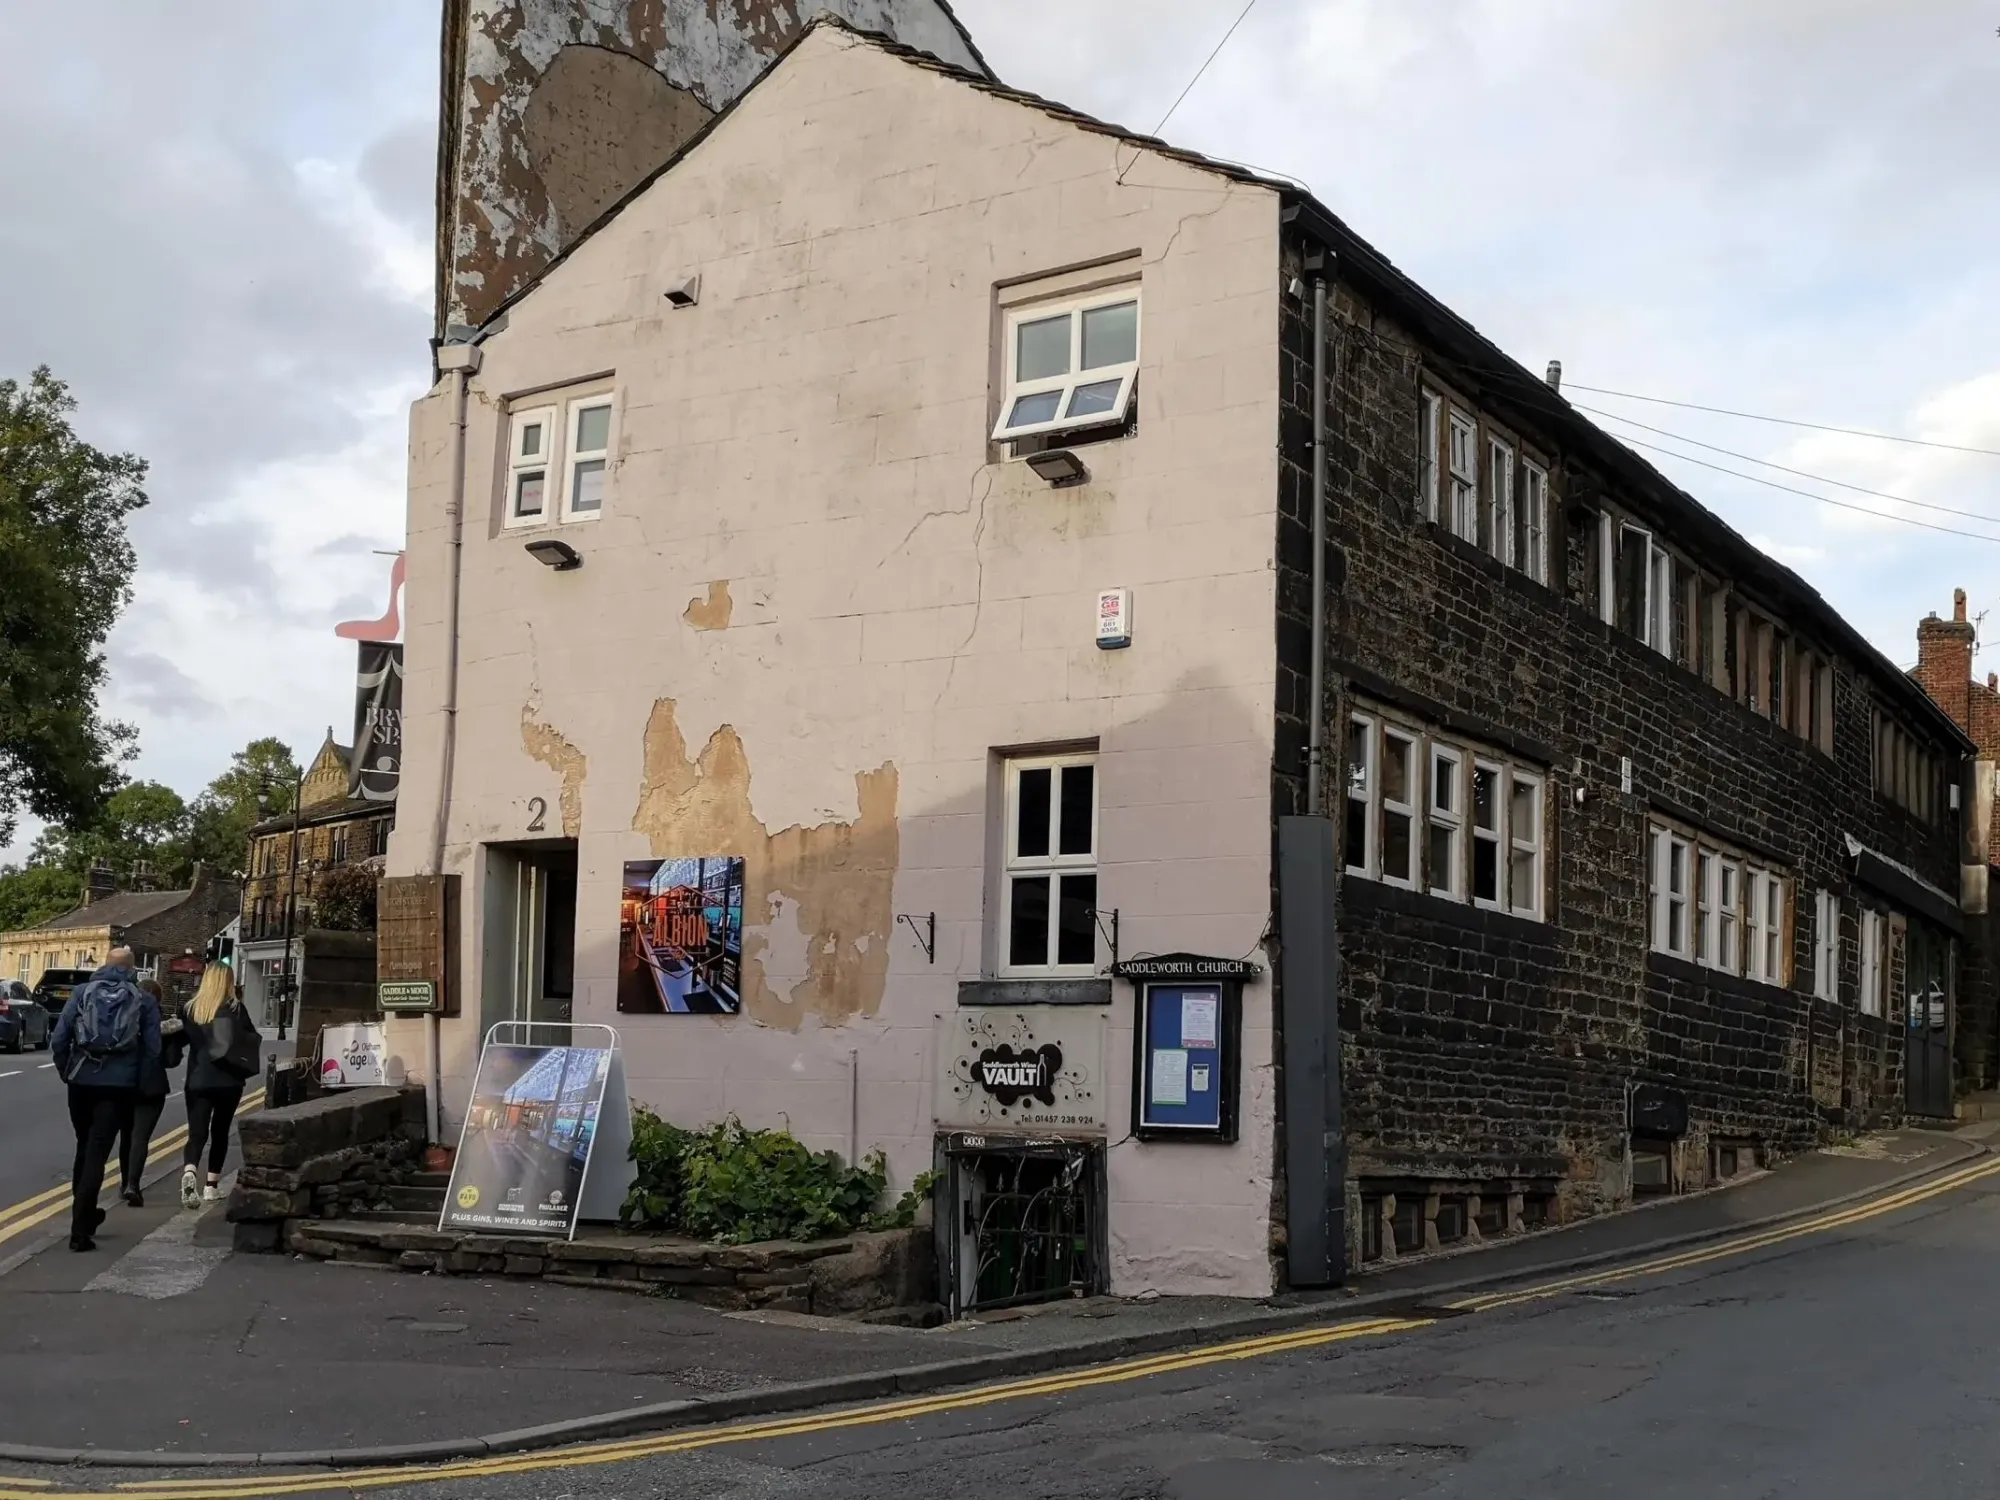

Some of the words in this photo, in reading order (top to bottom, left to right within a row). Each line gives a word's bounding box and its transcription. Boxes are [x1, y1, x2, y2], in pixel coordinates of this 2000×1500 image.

[526, 797, 547, 832] 2
[652, 914, 708, 947] ALBION
[1119, 962, 1192, 974] SADDLEWORTH
[1196, 961, 1244, 973] CHURCH
[410, 986, 429, 995] MOOR
[982, 1068, 1037, 1086] VAULT
[1021, 1114, 1032, 1123] Tel:
[1035, 1115, 1058, 1123] 01457
[1061, 1115, 1076, 1124] 238
[1078, 1116, 1093, 1125] 924
[451, 1212, 471, 1221] PLUS
[472, 1214, 493, 1224] GINS,
[494, 1215, 519, 1225] WINES
[520, 1217, 538, 1226] AND
[538, 1219, 567, 1228] SPIRITS
